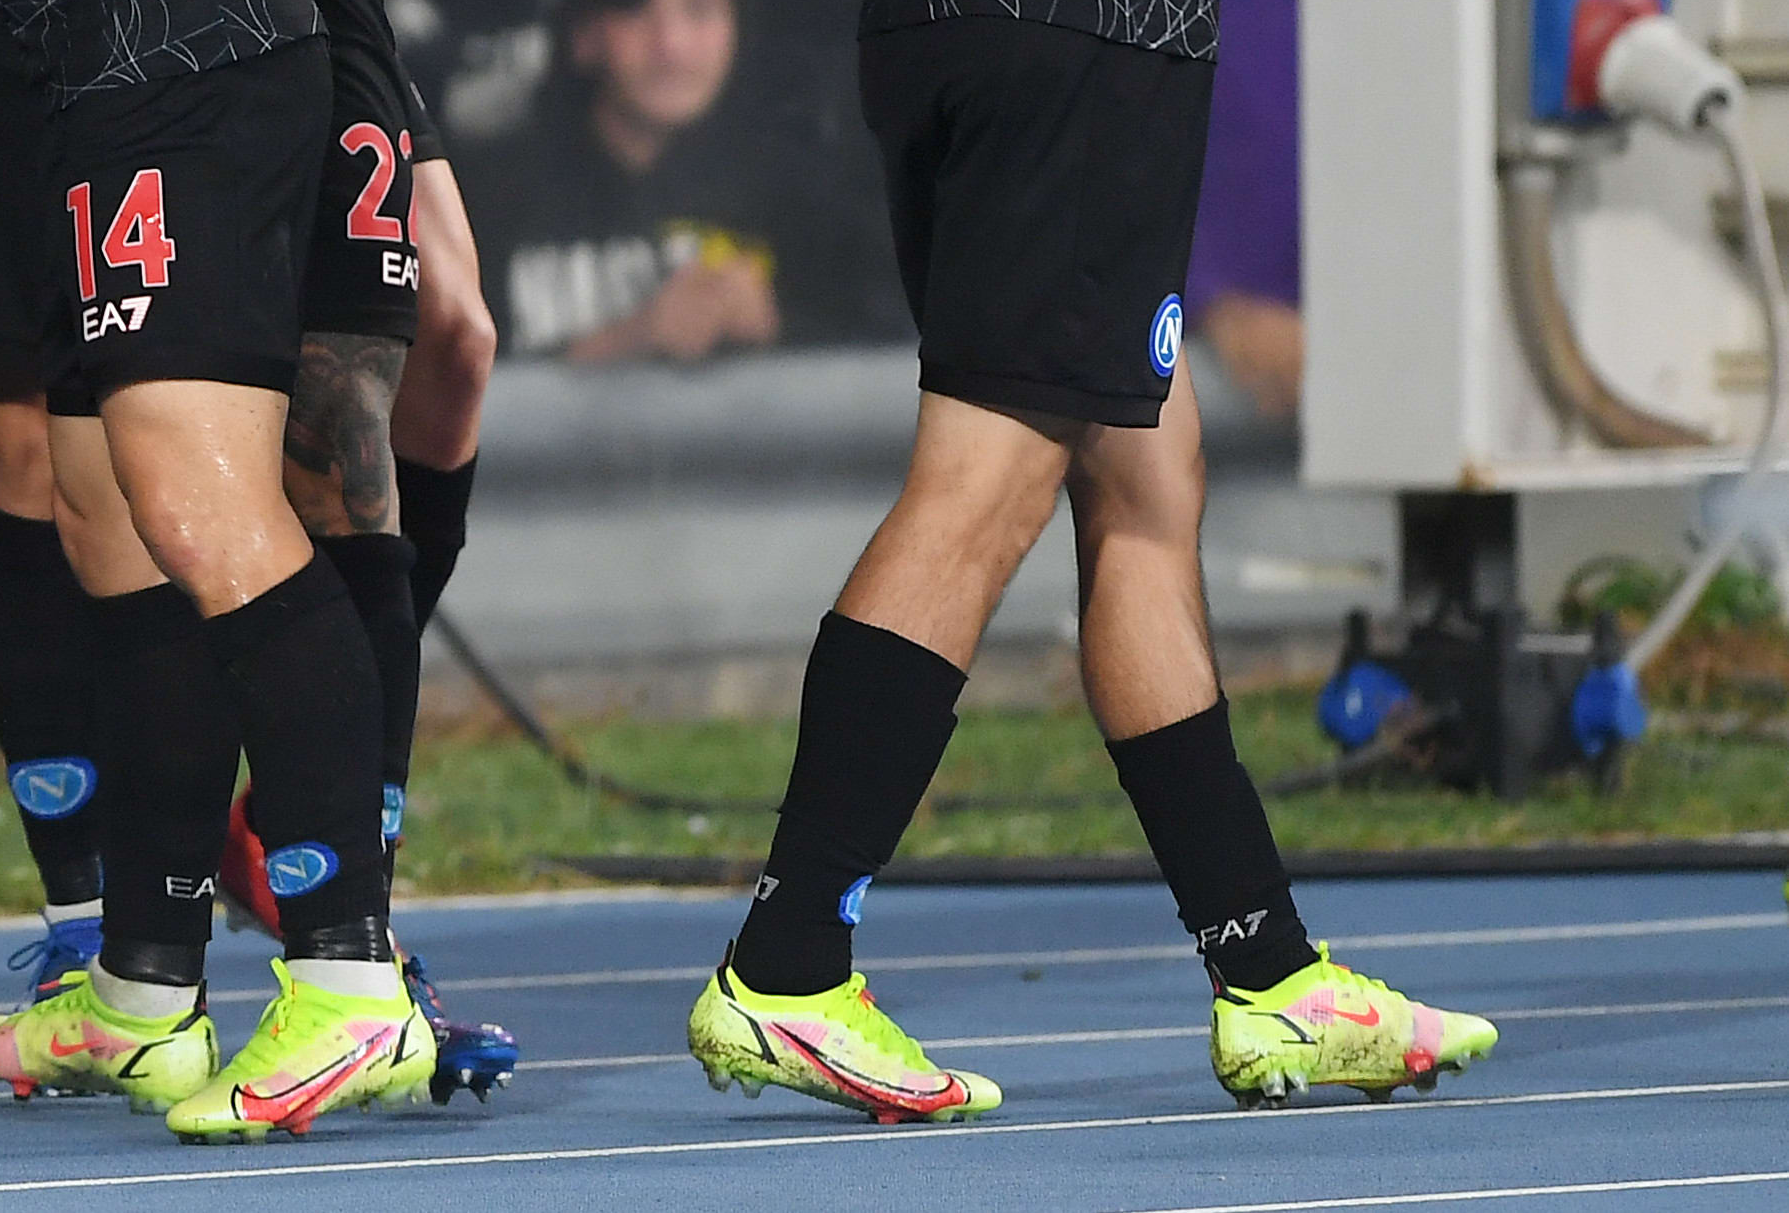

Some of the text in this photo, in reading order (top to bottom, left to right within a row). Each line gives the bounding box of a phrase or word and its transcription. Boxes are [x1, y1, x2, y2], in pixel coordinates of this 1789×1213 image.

[66, 168, 177, 303] 14
[82, 295, 153, 342] EA7
[1200, 908, 1269, 951] EA7
